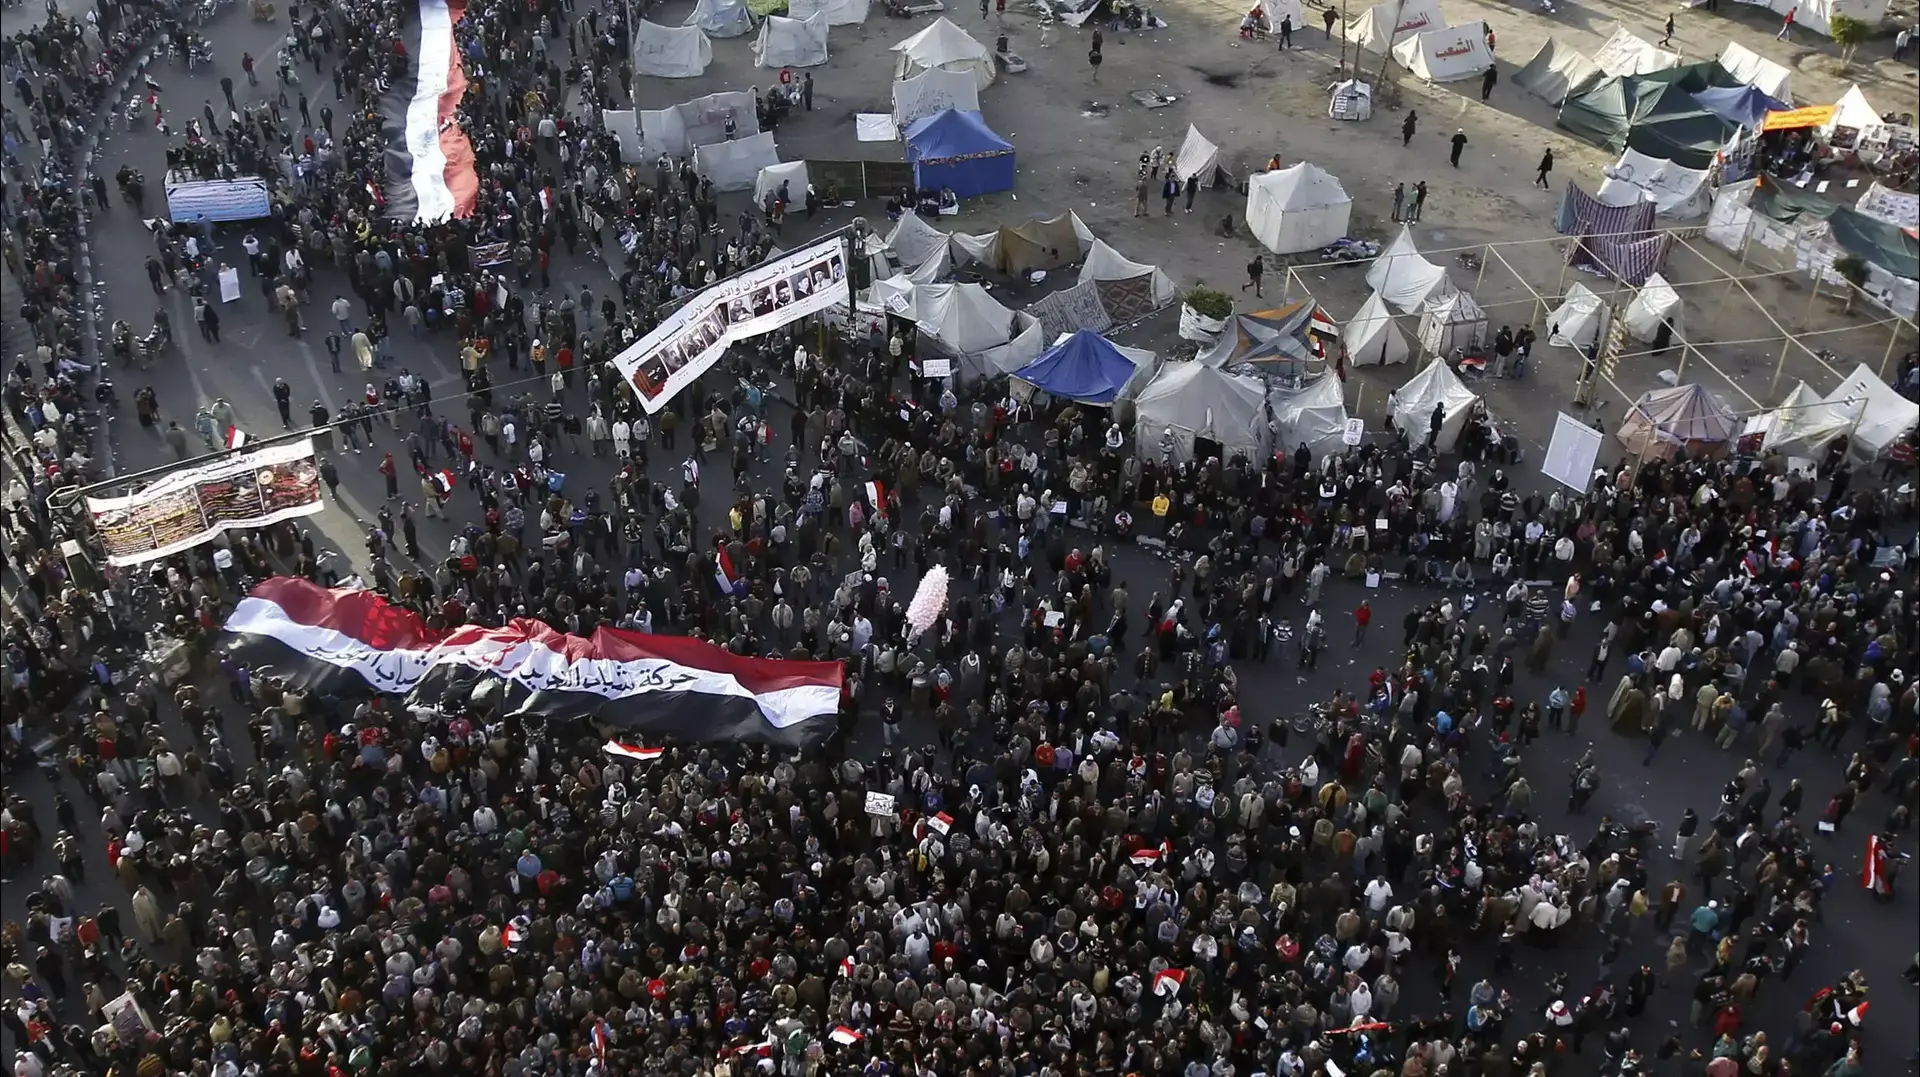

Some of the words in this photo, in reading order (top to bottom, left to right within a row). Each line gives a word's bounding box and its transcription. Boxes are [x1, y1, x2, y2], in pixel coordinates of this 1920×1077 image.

[789, 242, 840, 271] جماعة
[374, 654, 428, 690] شباب
[583, 664, 635, 693] شباب
[638, 663, 699, 691] حركة
